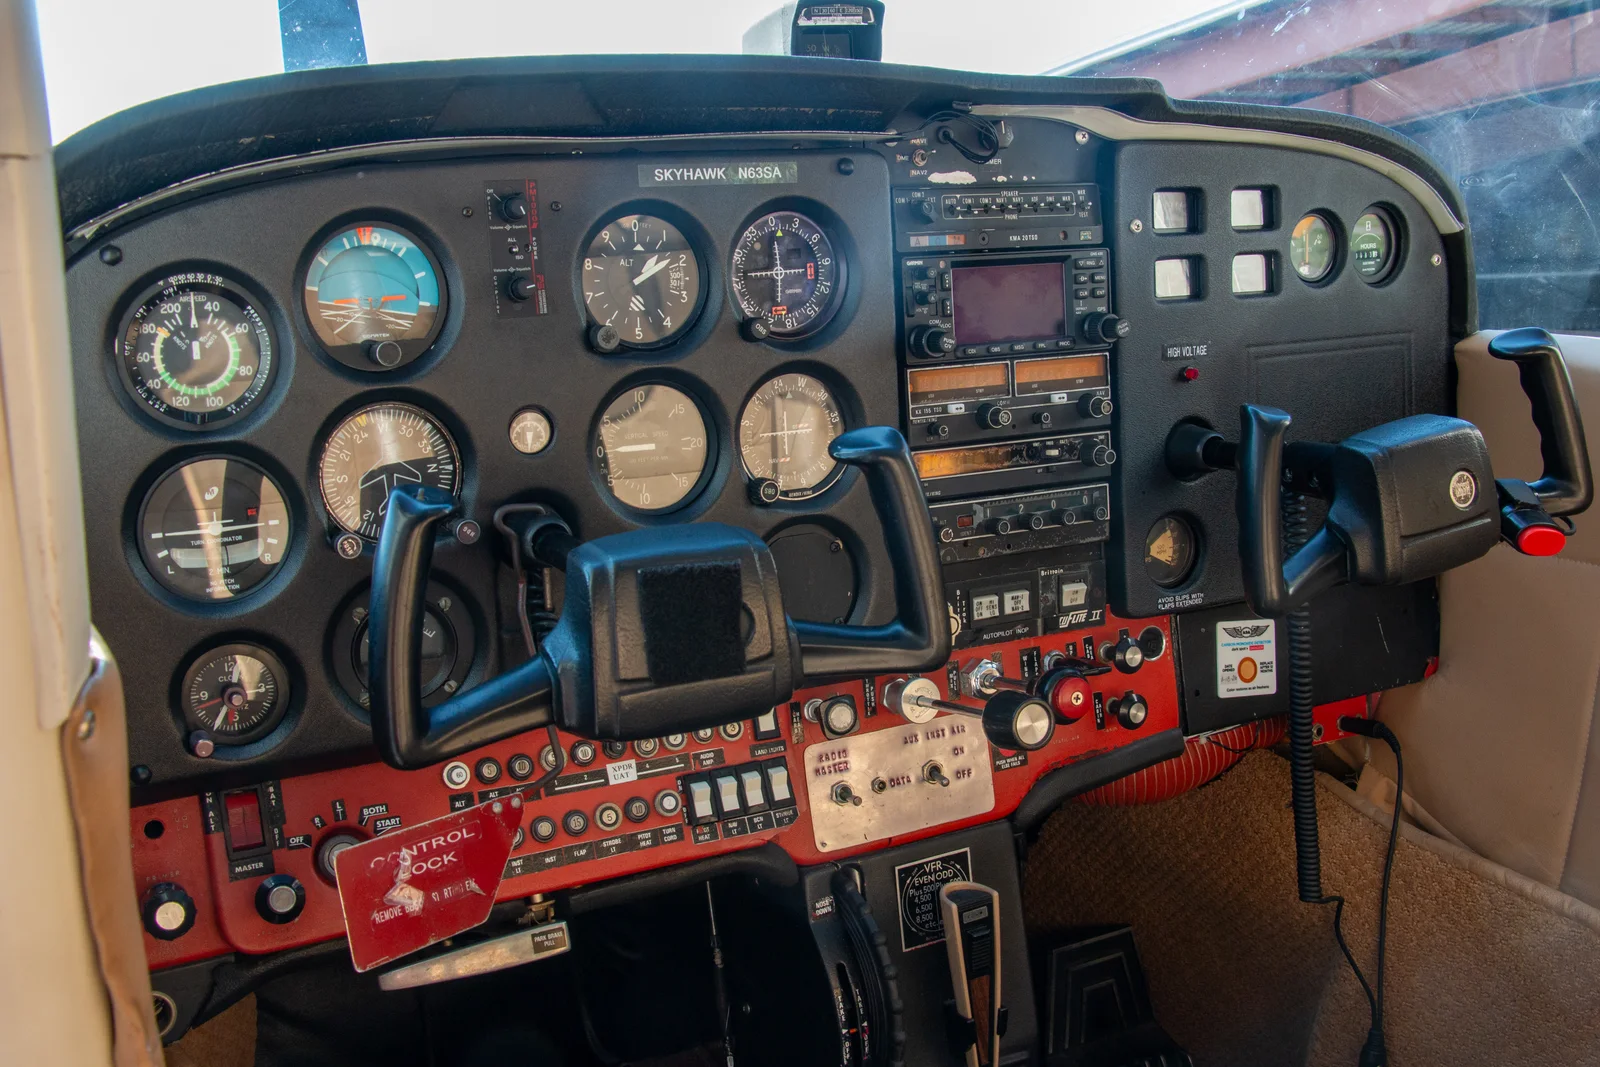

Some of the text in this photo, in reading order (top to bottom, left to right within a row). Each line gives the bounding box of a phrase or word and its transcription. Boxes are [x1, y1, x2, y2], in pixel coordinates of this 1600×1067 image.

[654, 166, 782, 182] SKYHAWK N63SA
[631, 219, 639, 232] 0
[768, 216, 775, 227] 0
[791, 217, 800, 228] 3
[601, 230, 610, 243] 9
[743, 226, 757, 241] 33
[811, 233, 820, 243] 6
[679, 254, 687, 267] 2
[732, 249, 743, 265] 30
[584, 258, 593, 270] 8
[619, 259, 634, 267] ALT
[820, 280, 831, 294] 12
[586, 292, 594, 304] 7
[680, 290, 688, 303] 3
[160, 303, 181, 314] 200
[204, 301, 220, 312] 40
[806, 304, 820, 318] 15
[663, 316, 672, 328] 4
[785, 317, 798, 329] 18
[235, 323, 249, 334] 60
[635, 327, 643, 340] 5
[755, 323, 767, 335] OBS
[1167, 344, 1208, 358] HIGH VOLTAGE
[239, 366, 253, 376] 80
[773, 379, 783, 390] 24
[797, 377, 808, 388] W
[634, 390, 645, 403] 10
[753, 393, 763, 405] 21
[817, 388, 829, 400] 30
[172, 396, 190, 407] 120
[206, 396, 224, 407] 100
[674, 403, 685, 415] 15
[603, 415, 611, 427] 5
[830, 411, 840, 423] 33
[741, 419, 751, 427] S
[353, 431, 369, 444] 24
[398, 426, 414, 438] 30
[624, 430, 669, 440] VERTICAL SPEED
[417, 439, 432, 454] 33
[690, 438, 703, 448] 20
[339, 449, 352, 462] 21
[596, 446, 604, 458] 0
[426, 463, 438, 473] N
[336, 475, 349, 483] S
[607, 475, 615, 487] 5
[678, 477, 689, 487] 15
[639, 493, 651, 505] 10
[1019, 504, 1024, 514] 2
[264, 553, 272, 562] R
[167, 565, 175, 574] L
[1040, 568, 1064, 577] Brittain
[1158, 596, 1174, 604] AVOID
[1175, 593, 1190, 602] SLIPS
[1158, 598, 1203, 610] FLAPS EXTENDED
[982, 626, 1029, 640] AUTOPILOT INOP
[199, 690, 209, 701] 9
[903, 724, 966, 745] AUX INST AIR
[818, 749, 848, 763] RADIO
[952, 747, 965, 756] ON
[611, 763, 634, 773] XPDR
[814, 762, 850, 777] MASTER
[955, 768, 973, 779] OFF
[613, 771, 630, 781] UAT
[889, 776, 912, 788] DATA
[268, 786, 276, 807] BAT
[455, 800, 466, 808] ALT
[363, 805, 387, 816] BOTH
[376, 817, 401, 828] START
[606, 812, 613, 822] 5
[753, 816, 764, 824] BCN
[289, 836, 304, 844] OFF
[637, 832, 651, 840] PITOT
[663, 834, 678, 842] CORD
[698, 833, 711, 841] HEAT
[602, 838, 622, 848] STROBE
[639, 839, 652, 847] HEAT
[573, 848, 587, 857] FLAP
[511, 858, 523, 866] INST
[544, 856, 557, 864] INST
[235, 862, 264, 873] MASTER
[923, 860, 943, 873] VFR
[914, 869, 954, 886] EVEN ODD
[909, 884, 935, 898] Plus 500
[815, 899, 830, 909] NOSE
[914, 893, 932, 904] 4,500
[374, 904, 403, 924] REMOVE
[815, 906, 832, 917] DOWN
[915, 903, 933, 914] 6,500
[915, 912, 934, 924] 8,500
[925, 921, 938, 929] etc.
[534, 931, 563, 943] PARK BRAKE
[855, 988, 864, 1015] TAKE
[837, 995, 846, 1022] TAKE
